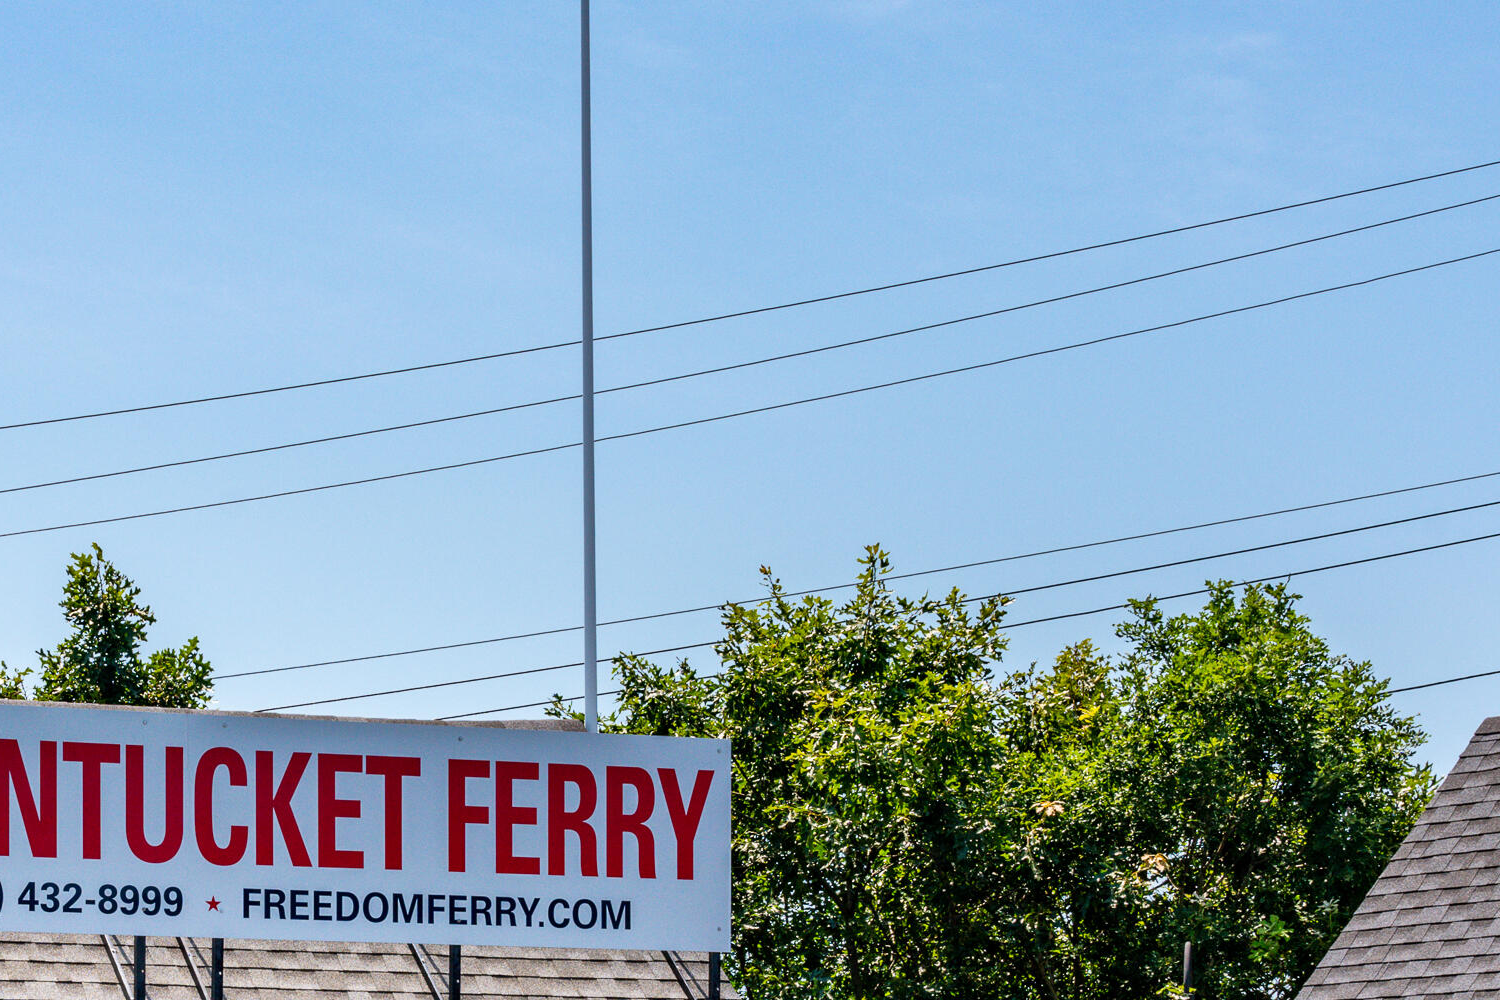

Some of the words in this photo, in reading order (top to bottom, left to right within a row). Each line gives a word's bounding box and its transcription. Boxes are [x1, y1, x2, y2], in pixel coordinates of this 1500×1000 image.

[448, 758, 715, 881] FERRY
[17, 882, 183, 917] 432-8999
[242, 888, 632, 930] FREEDOMFERRY.COM
